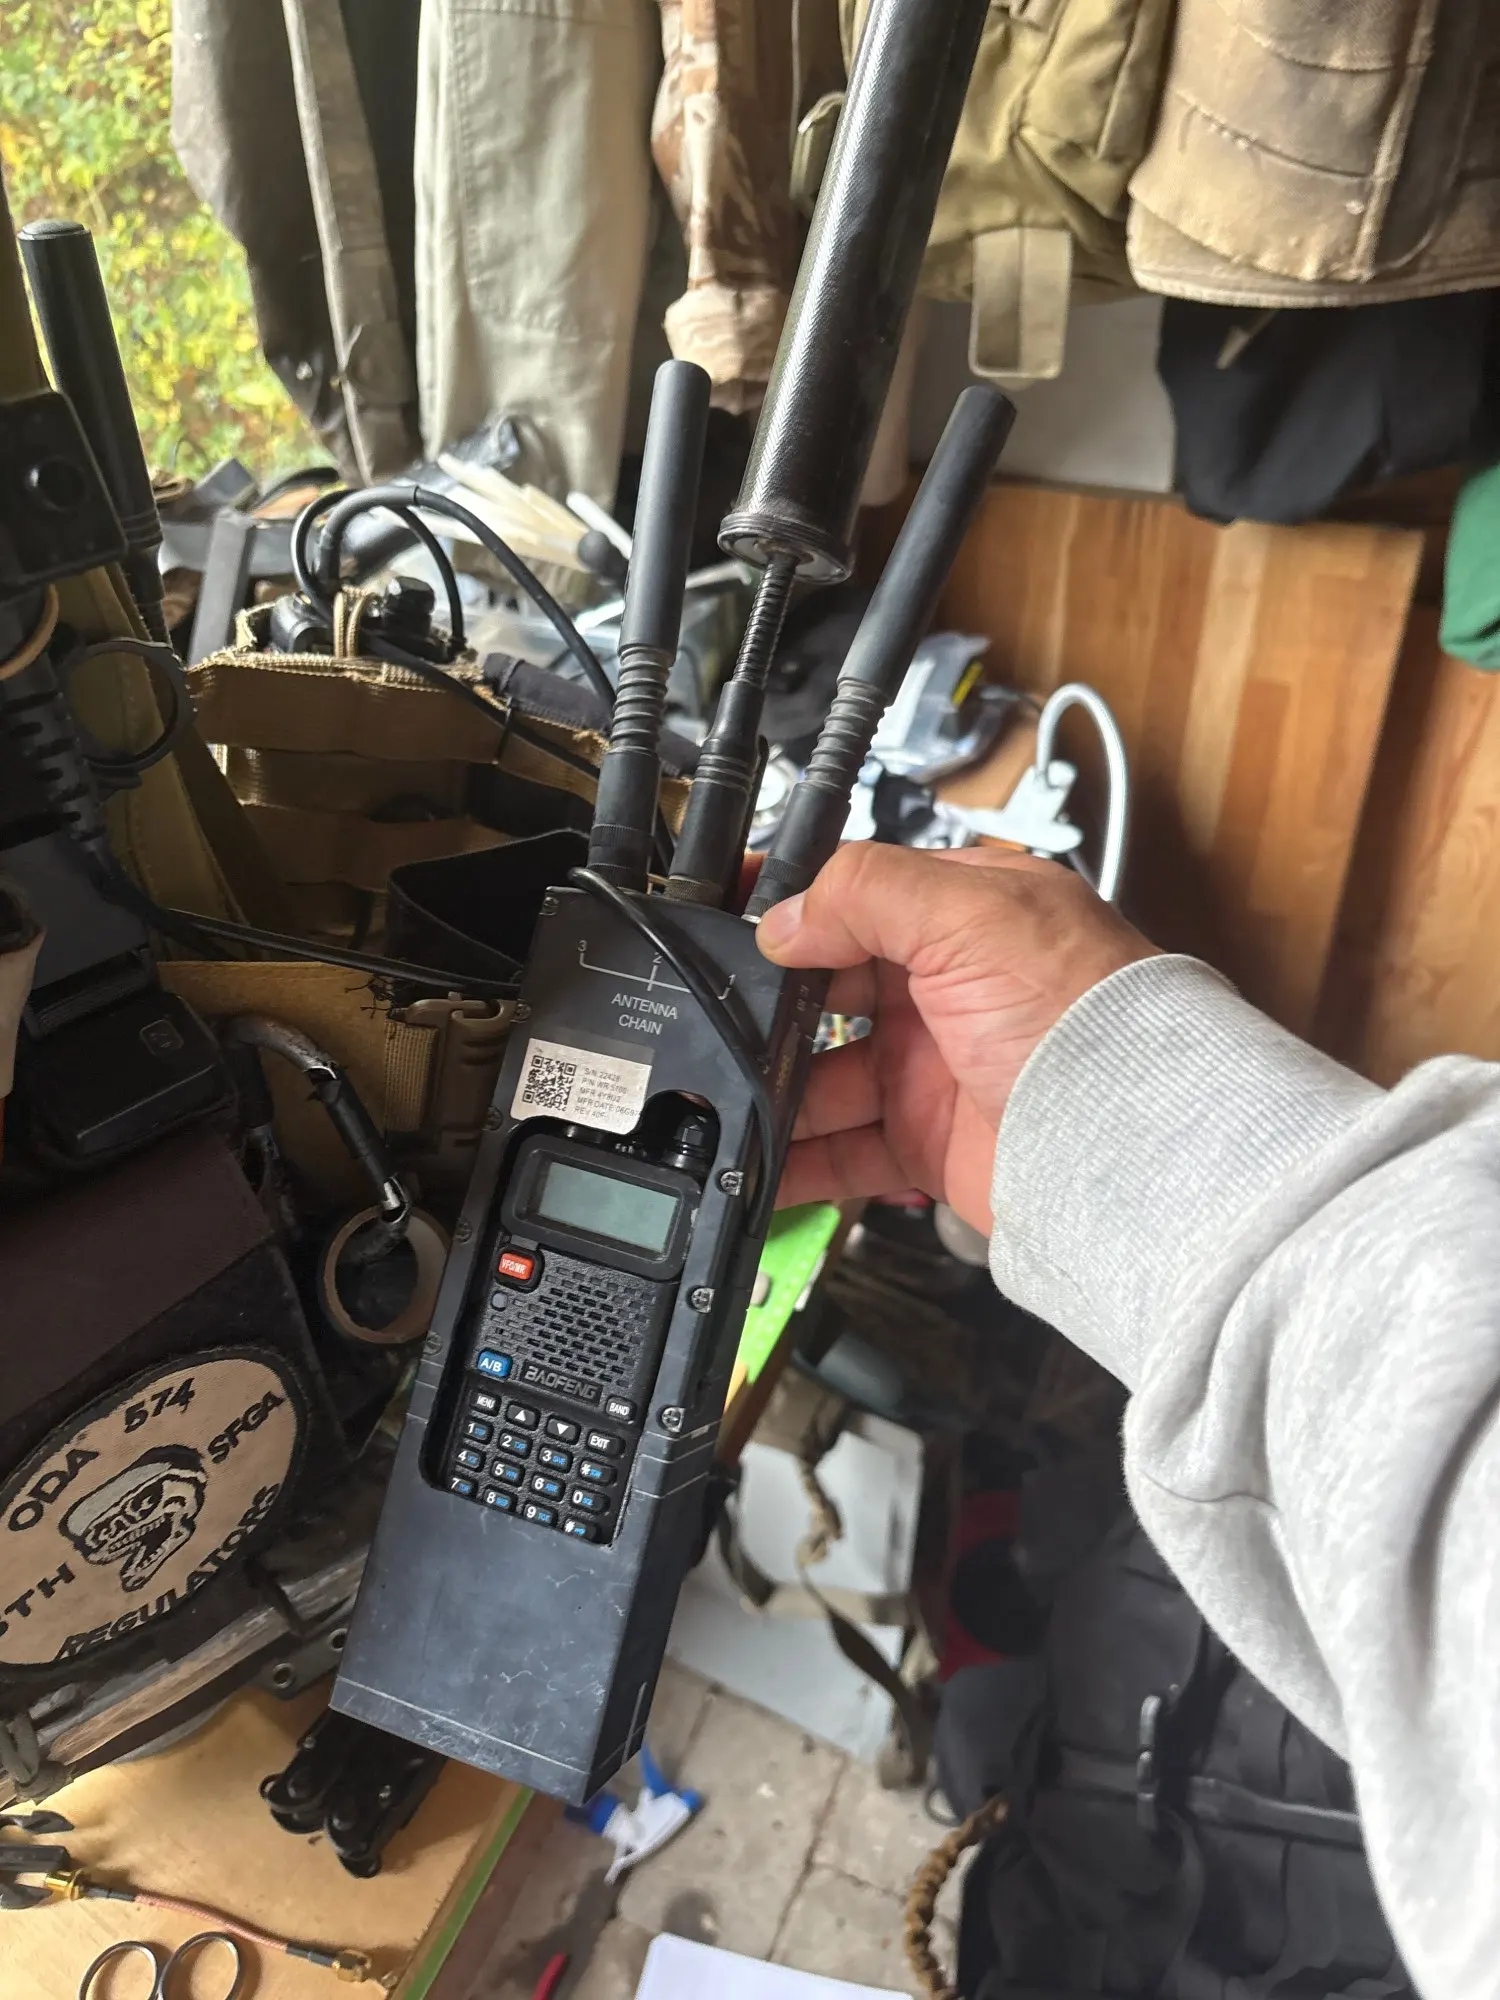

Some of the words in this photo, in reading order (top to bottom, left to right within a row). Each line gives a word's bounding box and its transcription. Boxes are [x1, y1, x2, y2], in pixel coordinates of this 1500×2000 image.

[577, 939, 588, 952] 3
[652, 951, 663, 964] 2
[728, 973, 737, 986] 1
[611, 993, 679, 1020] ANTENNA
[618, 1013, 663, 1036] CHAIN
[480, 1357, 503, 1372] A/B
[524, 1365, 599, 1399] BAOFENG
[476, 1392, 496, 1409] MENU
[609, 1401, 631, 1416] BAND
[207, 1390, 285, 1464] SFGA
[468, 1422, 475, 1434] 1
[501, 1435, 513, 1448] 2
[589, 1435, 611, 1450] EXIT
[8, 1448, 100, 1532] ODA
[123, 1377, 196, 1434] 574
[457, 1450, 468, 1461] 4
[542, 1449, 552, 1462] 3
[494, 1463, 505, 1476] 5
[450, 1477, 460, 1489] 7
[534, 1477, 545, 1490] 6
[486, 1491, 496, 1504] 8
[572, 1491, 583, 1504] 0
[526, 1505, 537, 1518] 9
